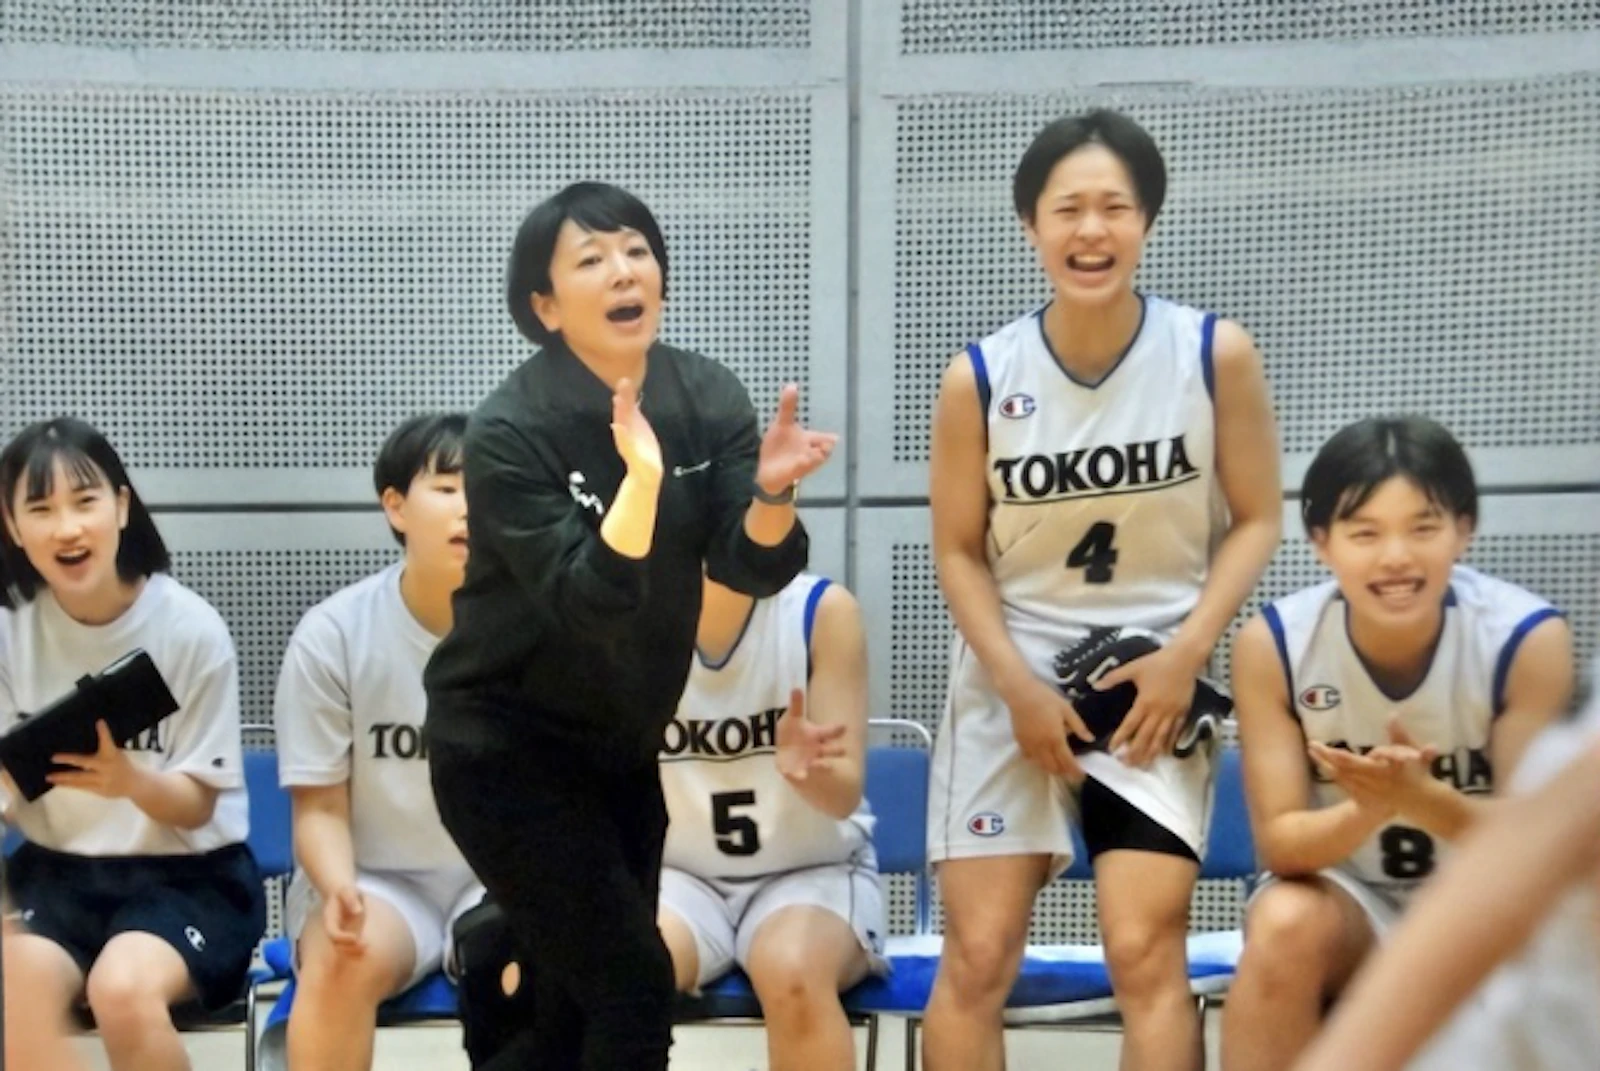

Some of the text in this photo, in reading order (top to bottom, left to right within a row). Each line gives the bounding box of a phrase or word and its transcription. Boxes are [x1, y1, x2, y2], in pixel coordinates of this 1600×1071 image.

[994, 434, 1198, 498] TOKOHA
[1066, 520, 1118, 584] 4
[660, 707, 787, 756] OKOH
[711, 790, 760, 857] 5
[1379, 825, 1435, 878] 8
